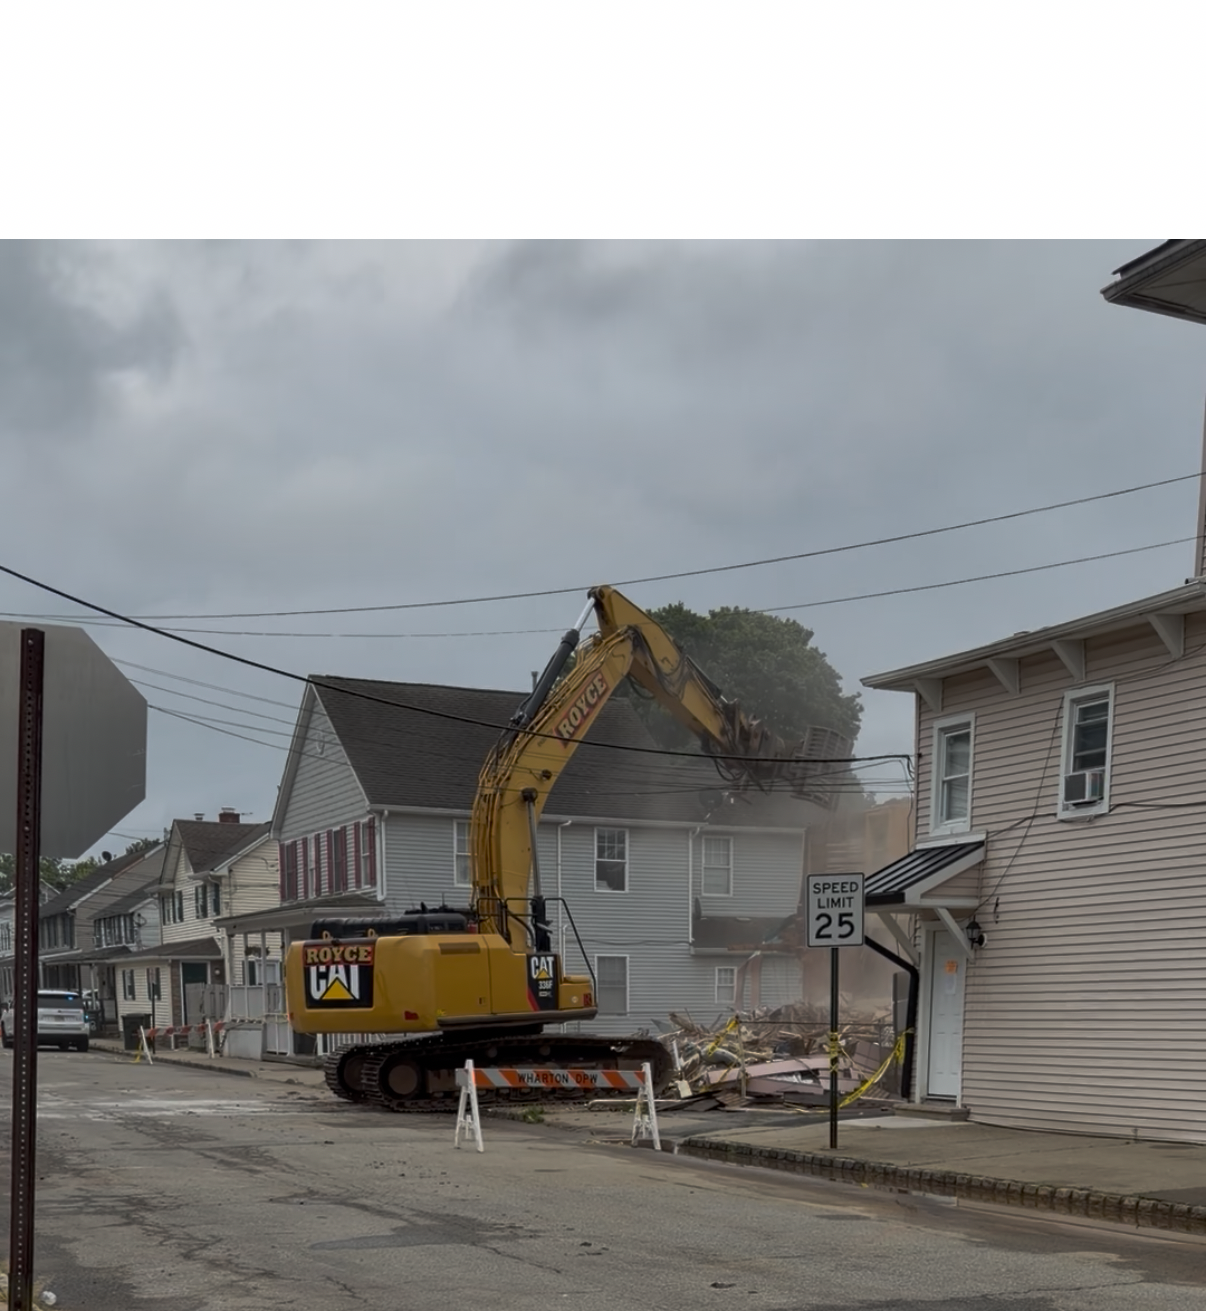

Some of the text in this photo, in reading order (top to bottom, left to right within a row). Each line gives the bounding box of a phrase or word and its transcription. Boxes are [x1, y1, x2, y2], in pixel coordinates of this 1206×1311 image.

[557, 672, 607, 740] ROYCE
[812, 881, 859, 894] SPEED
[817, 896, 854, 909] LIMIT
[815, 912, 855, 939] 25
[306, 945, 372, 964] ROYCE
[530, 956, 555, 979] CAT
[309, 964, 360, 1000] CAT
[517, 1073, 598, 1084] WHARTON DPW
